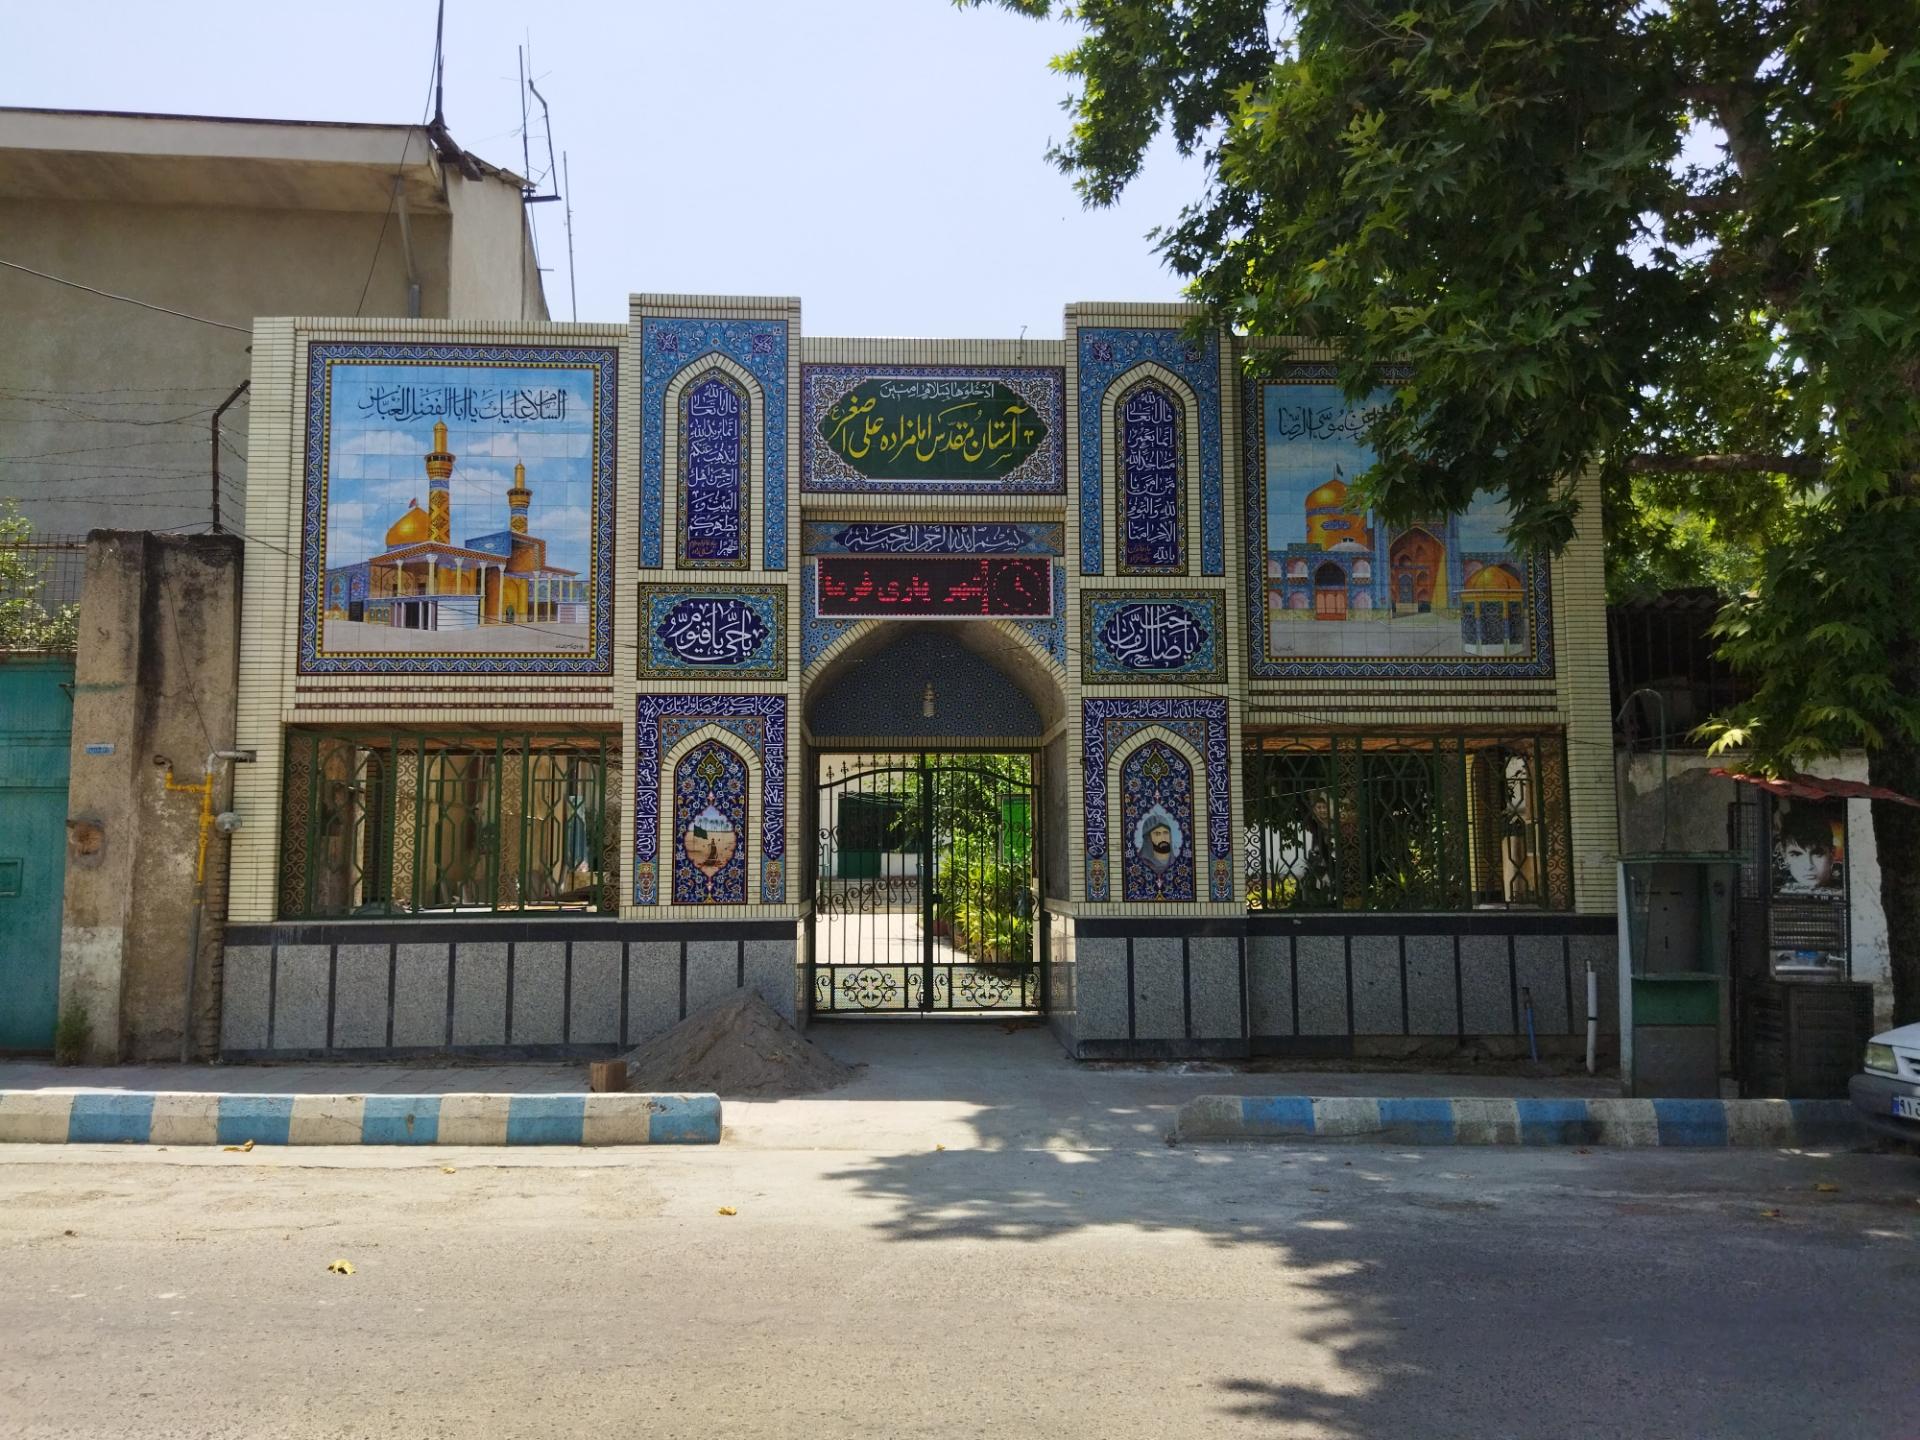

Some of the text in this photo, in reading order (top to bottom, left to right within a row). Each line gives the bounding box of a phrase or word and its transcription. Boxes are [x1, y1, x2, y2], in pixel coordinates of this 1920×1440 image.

[828, 394, 877, 453] اصغر
[849, 415, 885, 460] علی
[962, 406, 1029, 463] آستان
